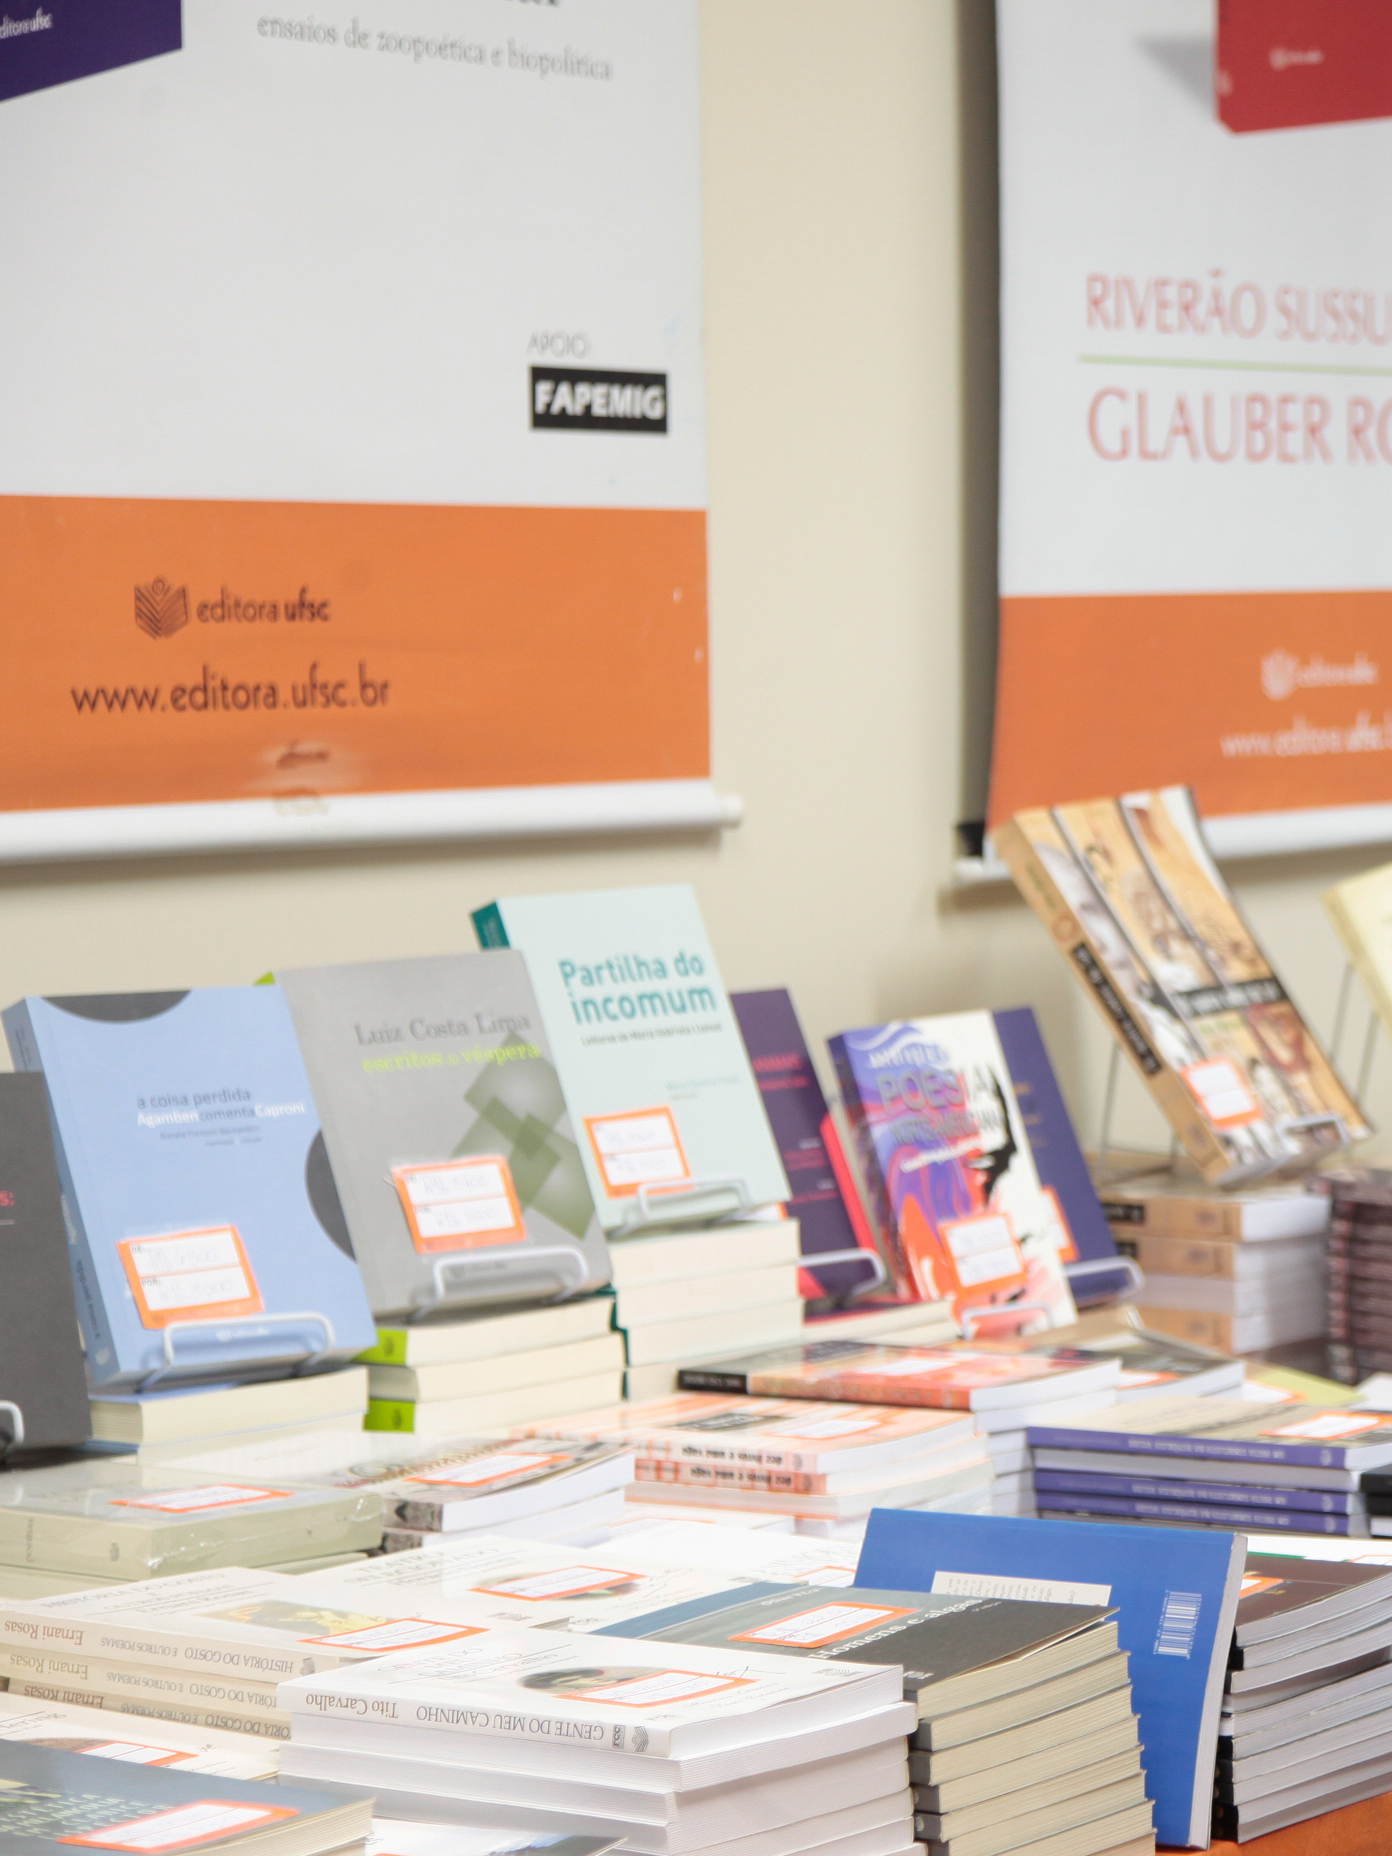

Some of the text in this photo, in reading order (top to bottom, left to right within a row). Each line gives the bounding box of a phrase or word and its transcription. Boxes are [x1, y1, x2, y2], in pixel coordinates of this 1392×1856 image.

[0, 14, 28, 39] ditora
[256, 14, 613, 81] ensaios de zoopoética e biopolítica
[1085, 267, 1267, 341] RIVERÃO
[526, 329, 592, 359] APOIO
[534, 379, 665, 420] FAPEMIG
[1087, 385, 1334, 467] GLAUBER
[196, 584, 331, 623] editora ufsc
[71, 659, 390, 713] www.editora.ufsc.br
[558, 949, 705, 989] Partilha do
[568, 986, 718, 1026] incomum
[354, 1011, 532, 1046] Luiz Costa Lima
[362, 1051, 443, 1073] escritos
[461, 1042, 541, 1066] véspera
[137, 1088, 251, 1109] a coisa perdida
[4, 1620, 84, 1646] Ernani Rosas
[808, 1623, 907, 1660] Homens
[907, 1617, 926, 1627] e
[924, 1597, 985, 1621] algas
[9, 1654, 89, 1681] Ernani Rosas
[100, 1637, 294, 1674] HISTÓRIA DO GOSTO E OUTROS POEMAS
[106, 1672, 142, 1686] POEMAS
[142, 1676, 177, 1693] OUTROS
[178, 1682, 184, 1693] E
[189, 1682, 226, 1700] GOSTO
[24, 1685, 104, 1709] Ernani Rosas
[226, 1687, 246, 1702] DO
[305, 1693, 399, 1720] Tito Carvalho
[121, 1703, 156, 1717] POEMAS
[156, 1708, 191, 1723] OUTROS
[192, 1713, 198, 1724] E
[204, 1713, 243, 1732] GOSTO
[415, 1705, 604, 1742] GENTE DO MEU CAMINHO
[243, 1720, 261, 1734] DO
